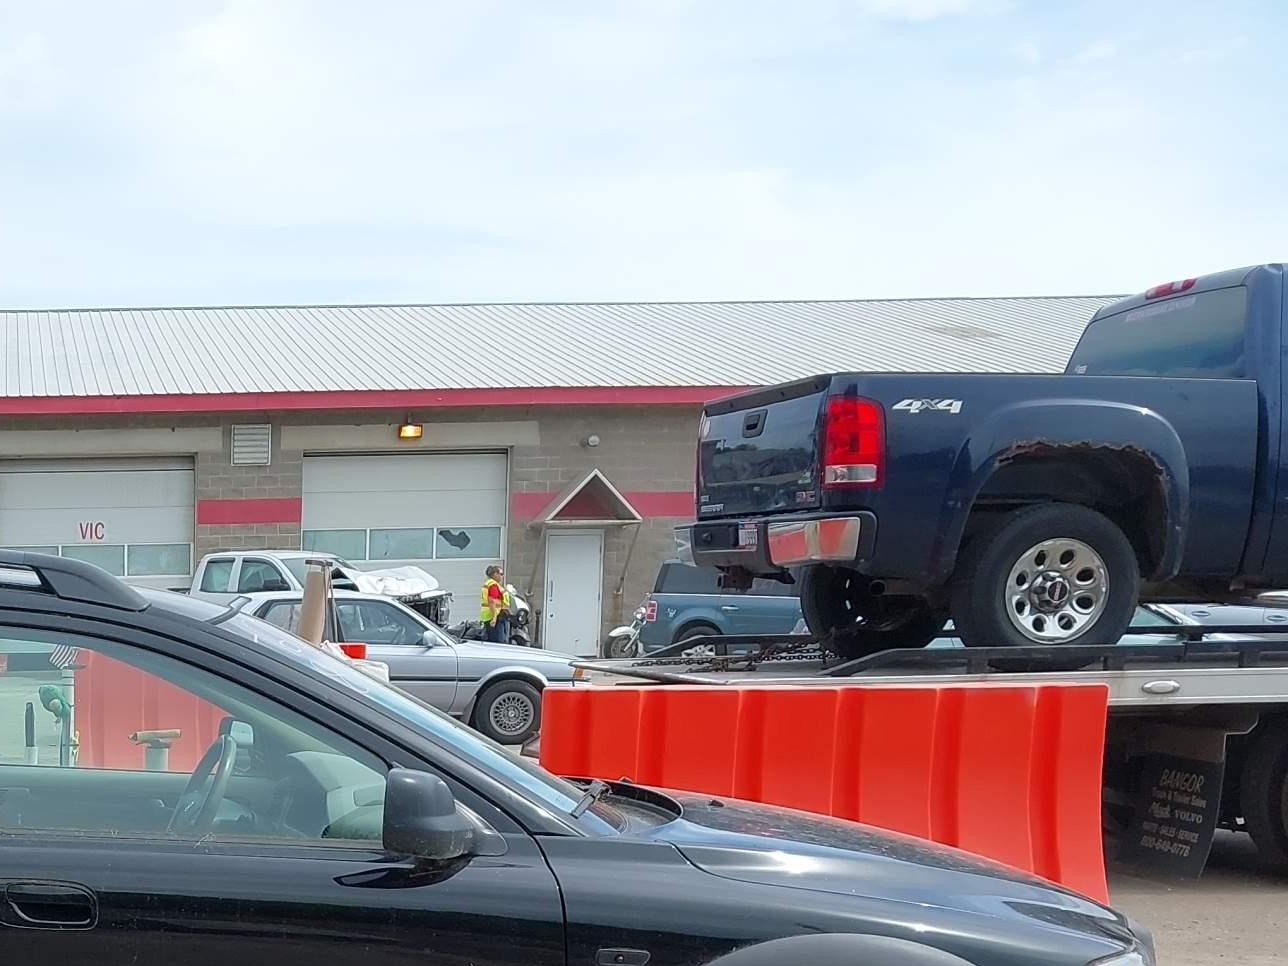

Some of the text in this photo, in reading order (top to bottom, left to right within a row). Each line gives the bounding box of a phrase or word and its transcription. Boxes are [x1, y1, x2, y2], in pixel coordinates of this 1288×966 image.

[79, 522, 105, 540] VIC
[1159, 768, 1205, 793] BANGOR
[1175, 809, 1203, 824] VOLVO
